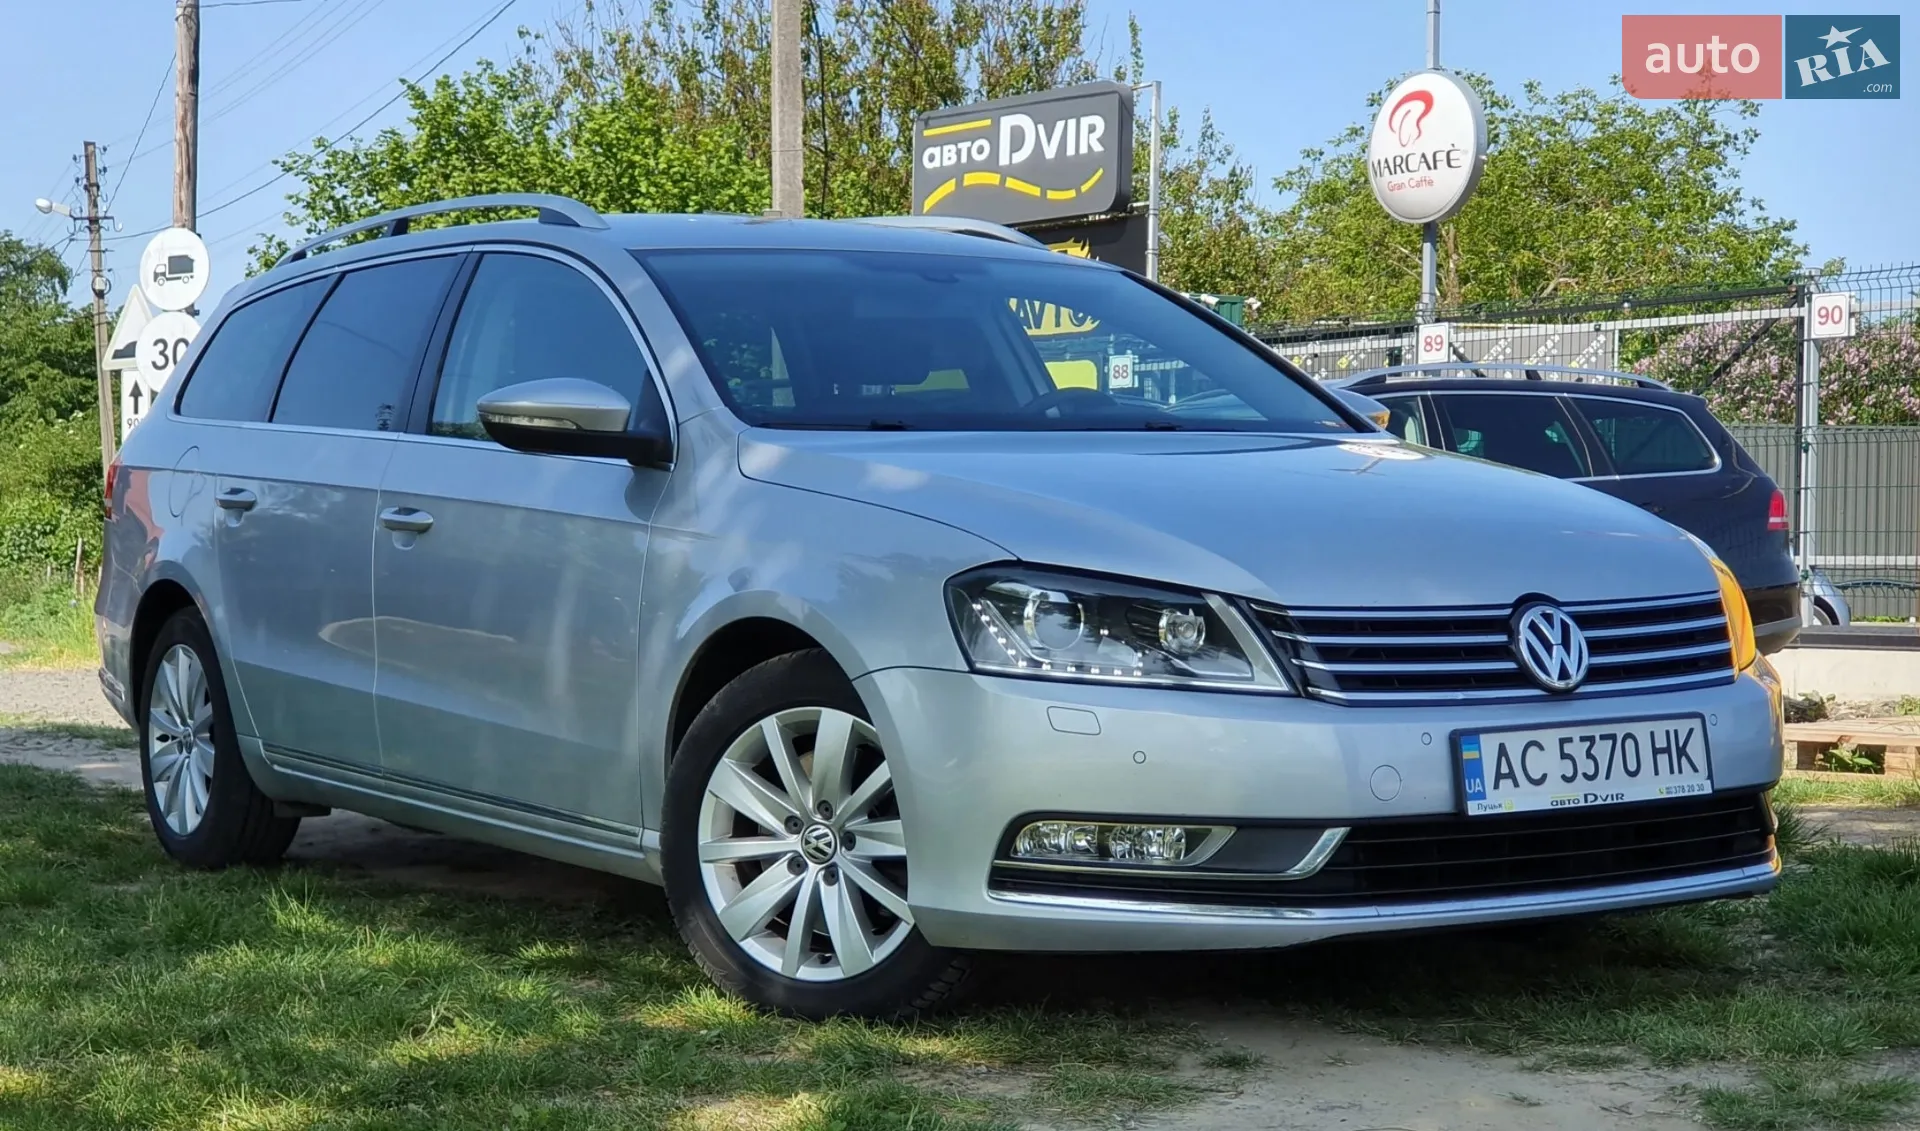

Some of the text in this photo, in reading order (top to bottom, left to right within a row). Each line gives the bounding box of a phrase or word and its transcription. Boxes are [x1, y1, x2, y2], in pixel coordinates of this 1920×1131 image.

[1371, 143, 1462, 178] MARCAFÈ
[1387, 180, 1406, 192] Gran
[1817, 304, 1843, 326] 90
[1423, 334, 1444, 353] 89
[151, 337, 190, 371] 30
[1112, 364, 1129, 380] 88
[1493, 727, 1700, 790] AC 5370 HK
[1465, 777, 1484, 794] UA
[1673, 784, 1686, 794] 378
[1686, 783, 1695, 793] 20
[1696, 782, 1705, 792] 30
